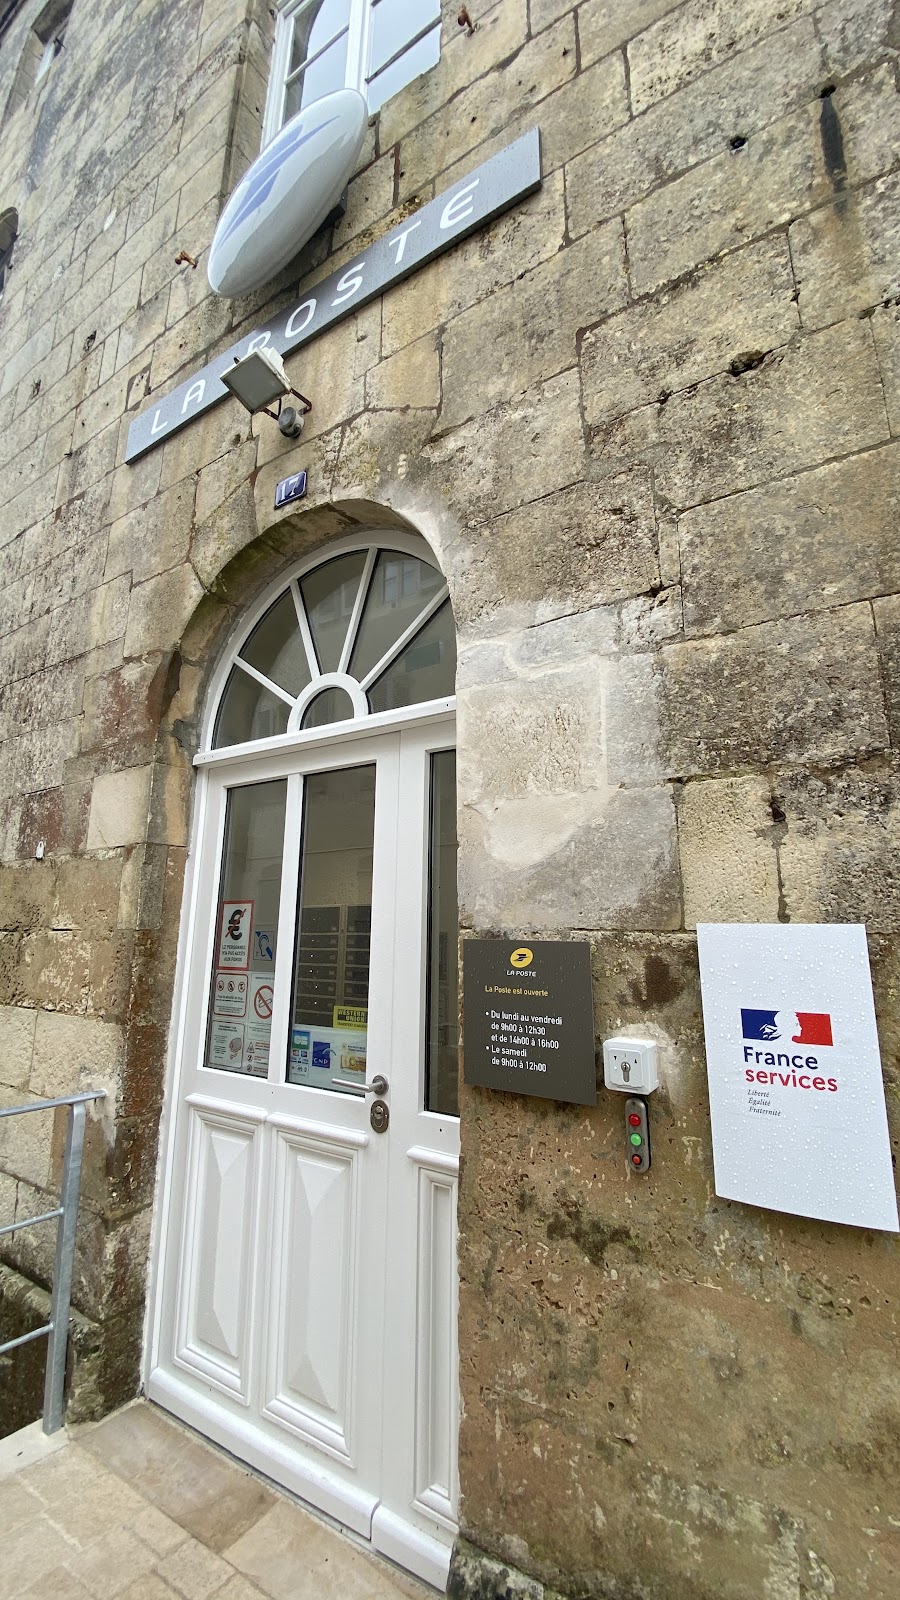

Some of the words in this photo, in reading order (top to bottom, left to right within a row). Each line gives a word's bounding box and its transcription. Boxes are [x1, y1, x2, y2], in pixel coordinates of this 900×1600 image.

[150, 379, 206, 435] LA
[281, 476, 300, 501] 17
[485, 985, 493, 993] La
[494, 986, 512, 994] Poste
[523, 989, 549, 997] ouverte
[338, 1009, 365, 1017] WESTERN
[491, 1010, 500, 1019] Du
[502, 1011, 519, 1020] lundi
[520, 1014, 530, 1022] au
[531, 1015, 563, 1025] vendredi
[491, 1022, 499, 1030] de
[500, 1023, 517, 1032] 9h00
[518, 1025, 523, 1033] à
[525, 1025, 546, 1035] 12h30
[499, 1034, 508, 1043] de
[509, 1035, 530, 1045] 14h00
[531, 1037, 536, 1046] à
[538, 1039, 559, 1049] 16h00
[491, 1045, 500, 1054] Le
[501, 1047, 527, 1057] samedi
[743, 1046, 819, 1070] France
[491, 1057, 500, 1065] de
[501, 1058, 518, 1068] 9h00
[519, 1060, 524, 1068] à
[525, 1061, 547, 1072] 12h00
[745, 1069, 838, 1092] services
[747, 1089, 770, 1098] Liberté
[748, 1106, 781, 1117] Fraternité
